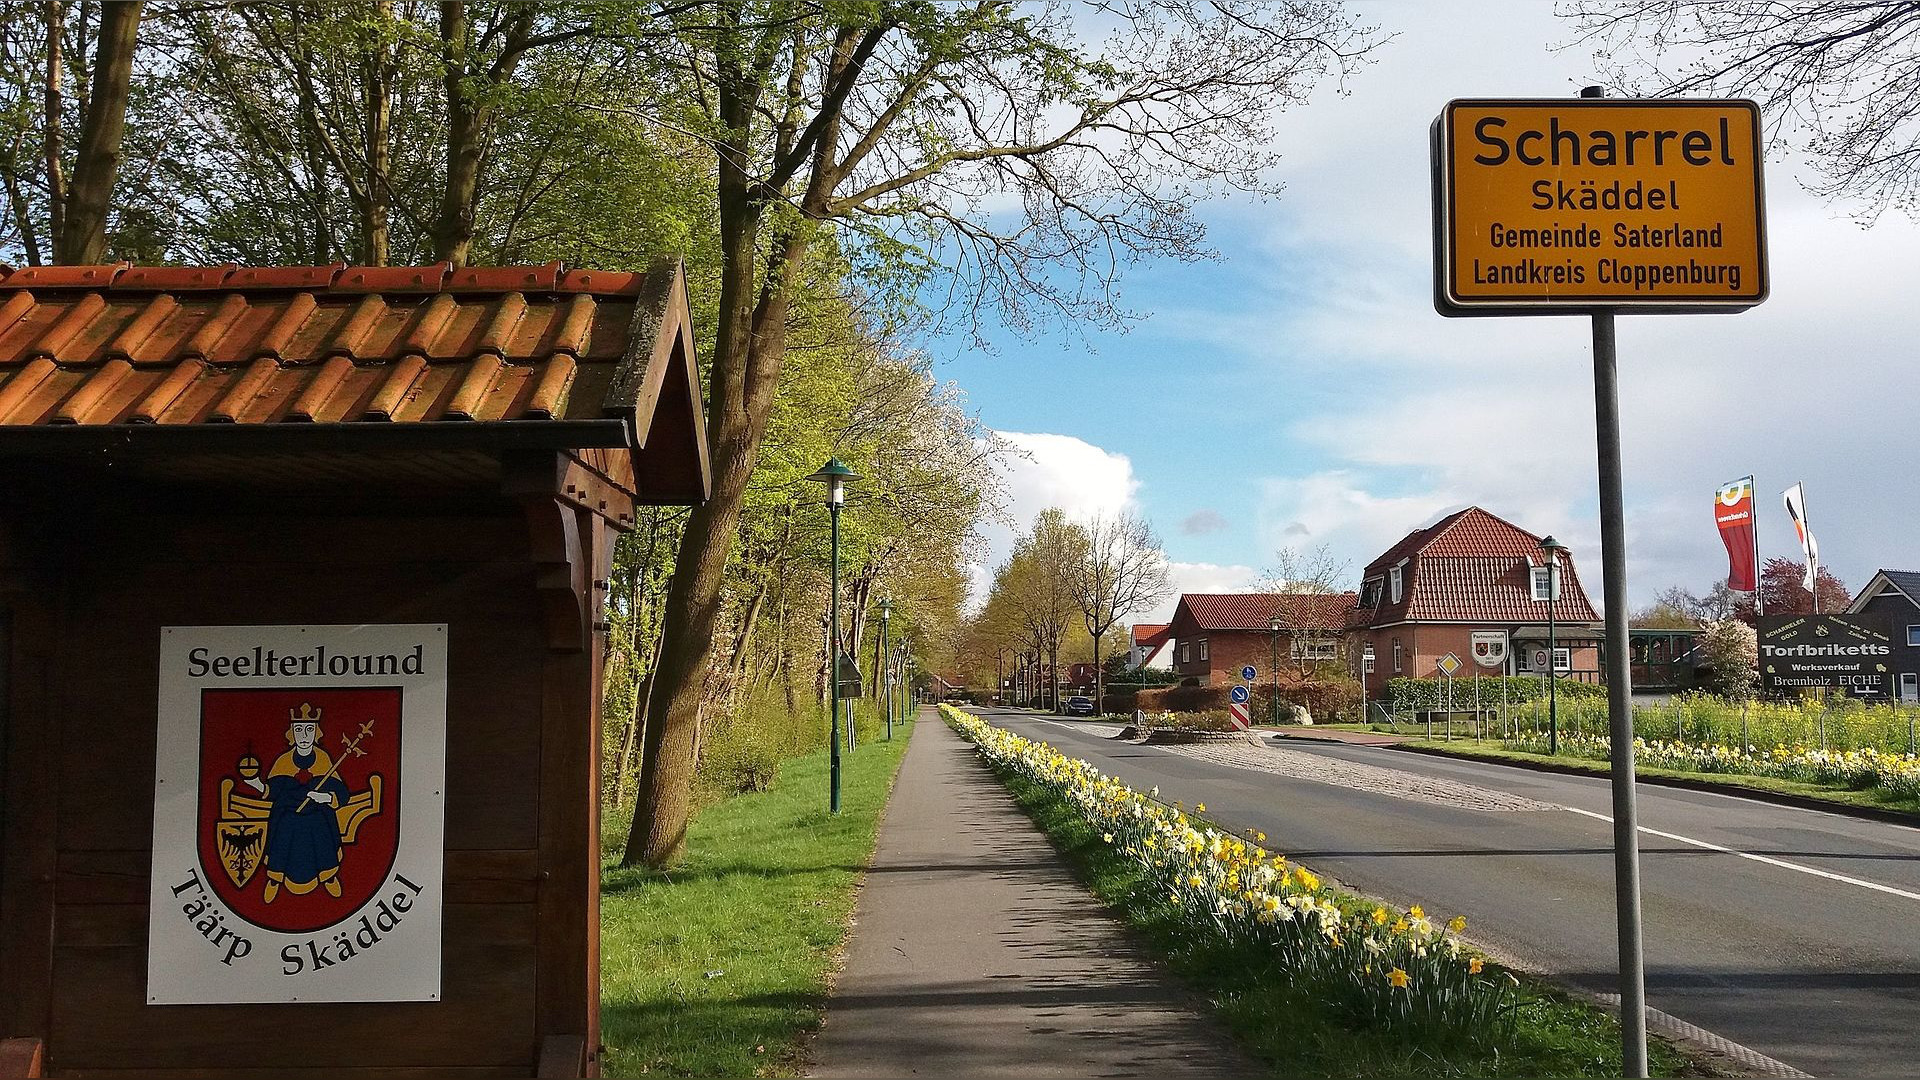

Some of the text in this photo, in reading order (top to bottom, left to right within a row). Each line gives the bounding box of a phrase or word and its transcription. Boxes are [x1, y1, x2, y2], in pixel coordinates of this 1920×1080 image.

[1474, 116, 1735, 166] Scharrel
[1532, 180, 1679, 210] Skäddel
[1490, 222, 1722, 248] Gemeinde Saterland
[1474, 259, 1741, 290] Landkreis Cloppenburg
[1765, 618, 1806, 638] SCHARRELER
[1780, 630, 1798, 641] GOLD
[187, 645, 425, 678] Seelterlound
[1762, 643, 1890, 657] Torfbriketts
[1774, 675, 1882, 686] Brennholz EICHE
[1791, 663, 1861, 672] Werksverkauf
[170, 868, 424, 976] Täärp Skäddel
